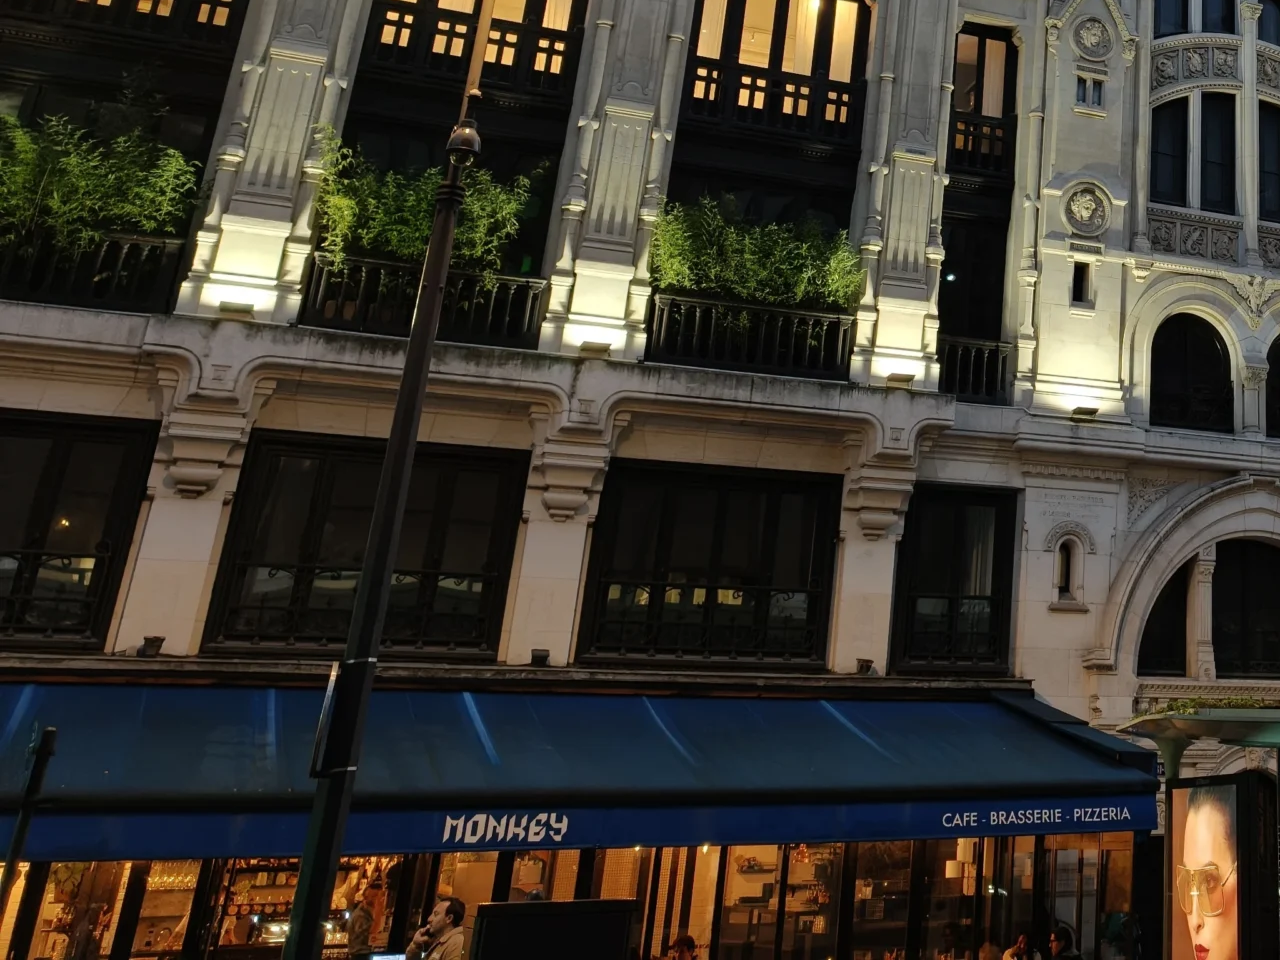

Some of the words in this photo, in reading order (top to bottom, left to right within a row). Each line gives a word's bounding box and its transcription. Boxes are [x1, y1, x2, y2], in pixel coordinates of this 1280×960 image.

[442, 812, 569, 843] MONKEY
[942, 812, 978, 827] CAFE
[990, 808, 1062, 825] BRASSERIE
[1073, 806, 1131, 822] PIZZERIA
